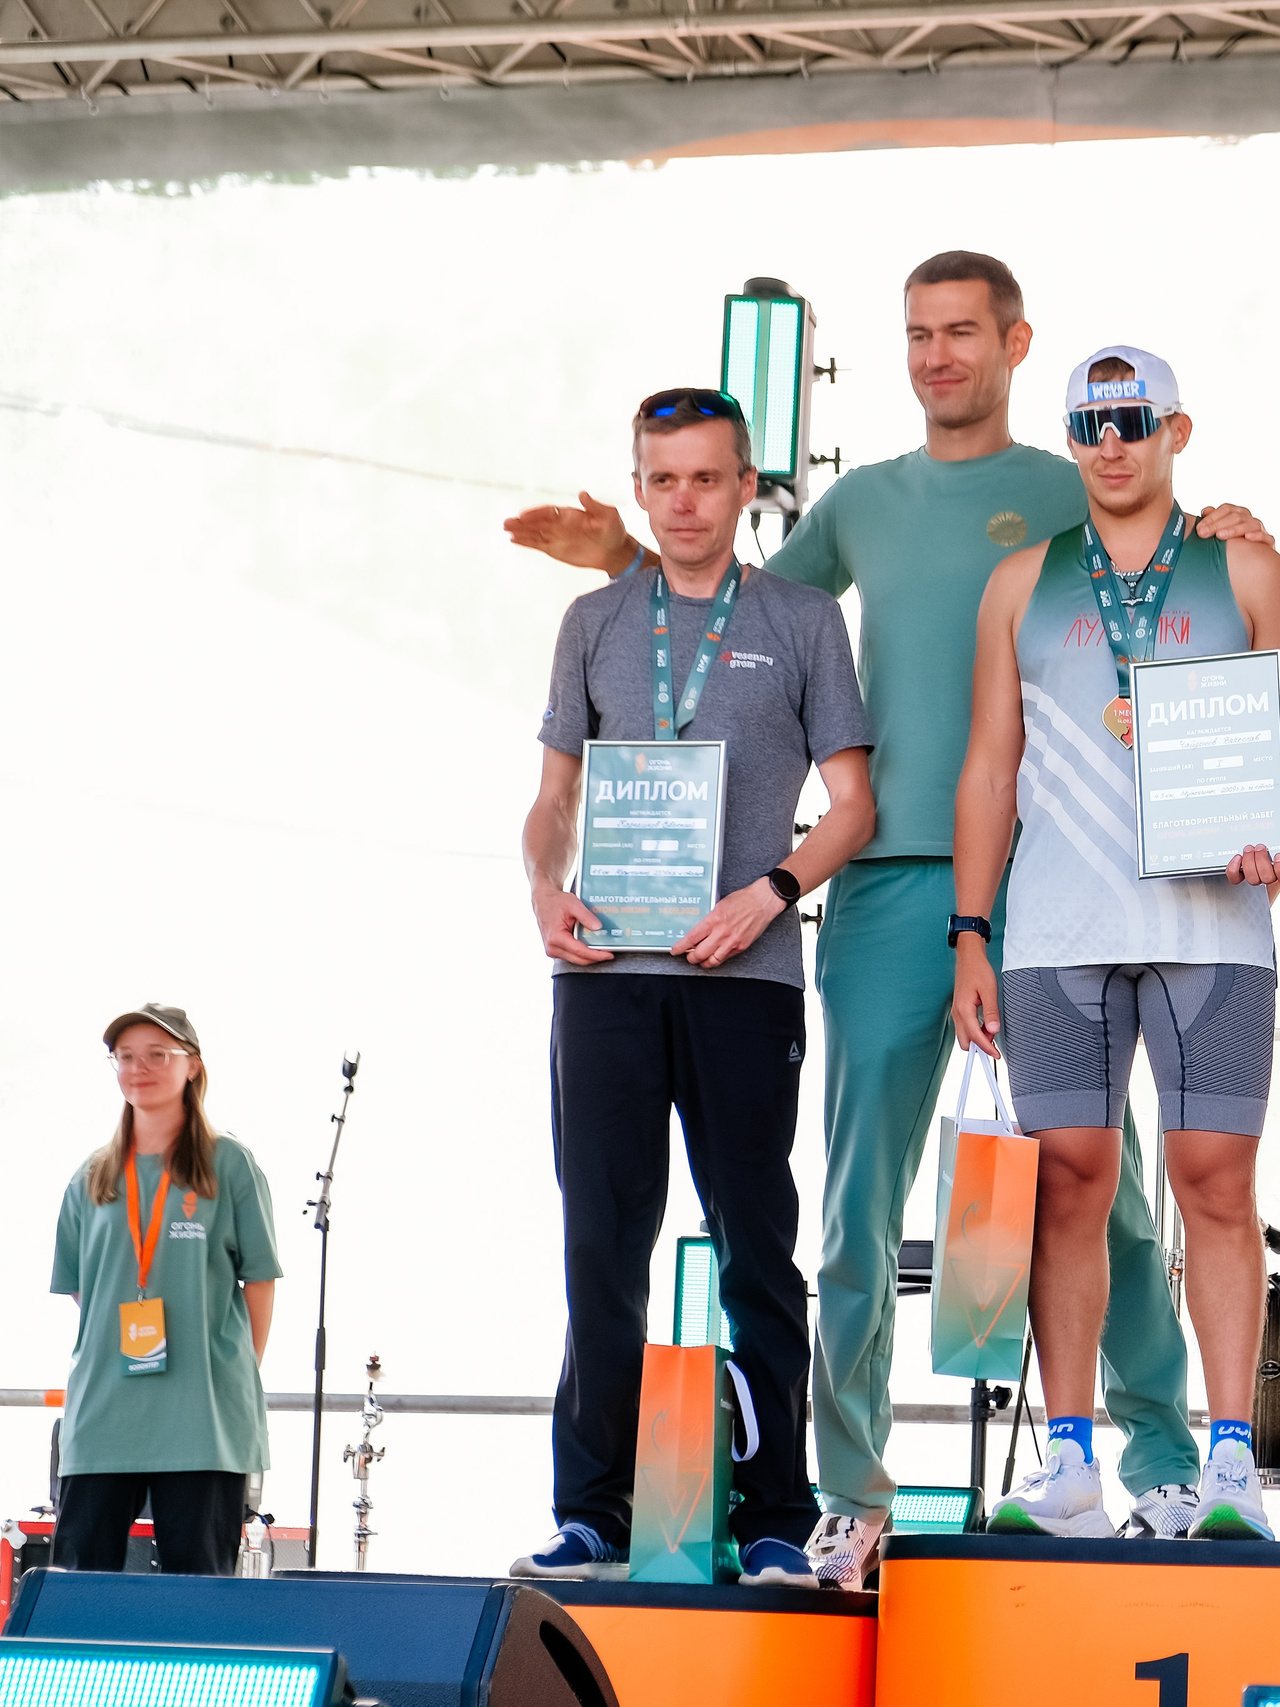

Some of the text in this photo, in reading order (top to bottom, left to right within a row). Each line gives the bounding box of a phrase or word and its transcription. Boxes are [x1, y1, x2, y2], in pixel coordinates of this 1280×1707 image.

[1147, 691, 1269, 727] ДИПЛОМ
[1186, 727, 1231, 735] НАГРАЖДАЕТСЯ
[595, 780, 708, 804] ДИПЛОМ
[1152, 810, 1274, 829] БЛАГОТВОРИТЕЛЬНЫЙ ЗАБЕГ
[589, 894, 701, 904] БЛАГОТВОРИТЕЛЬНЫЙ ЗАБЕГ
[1135, 1652, 1188, 1707] 1
